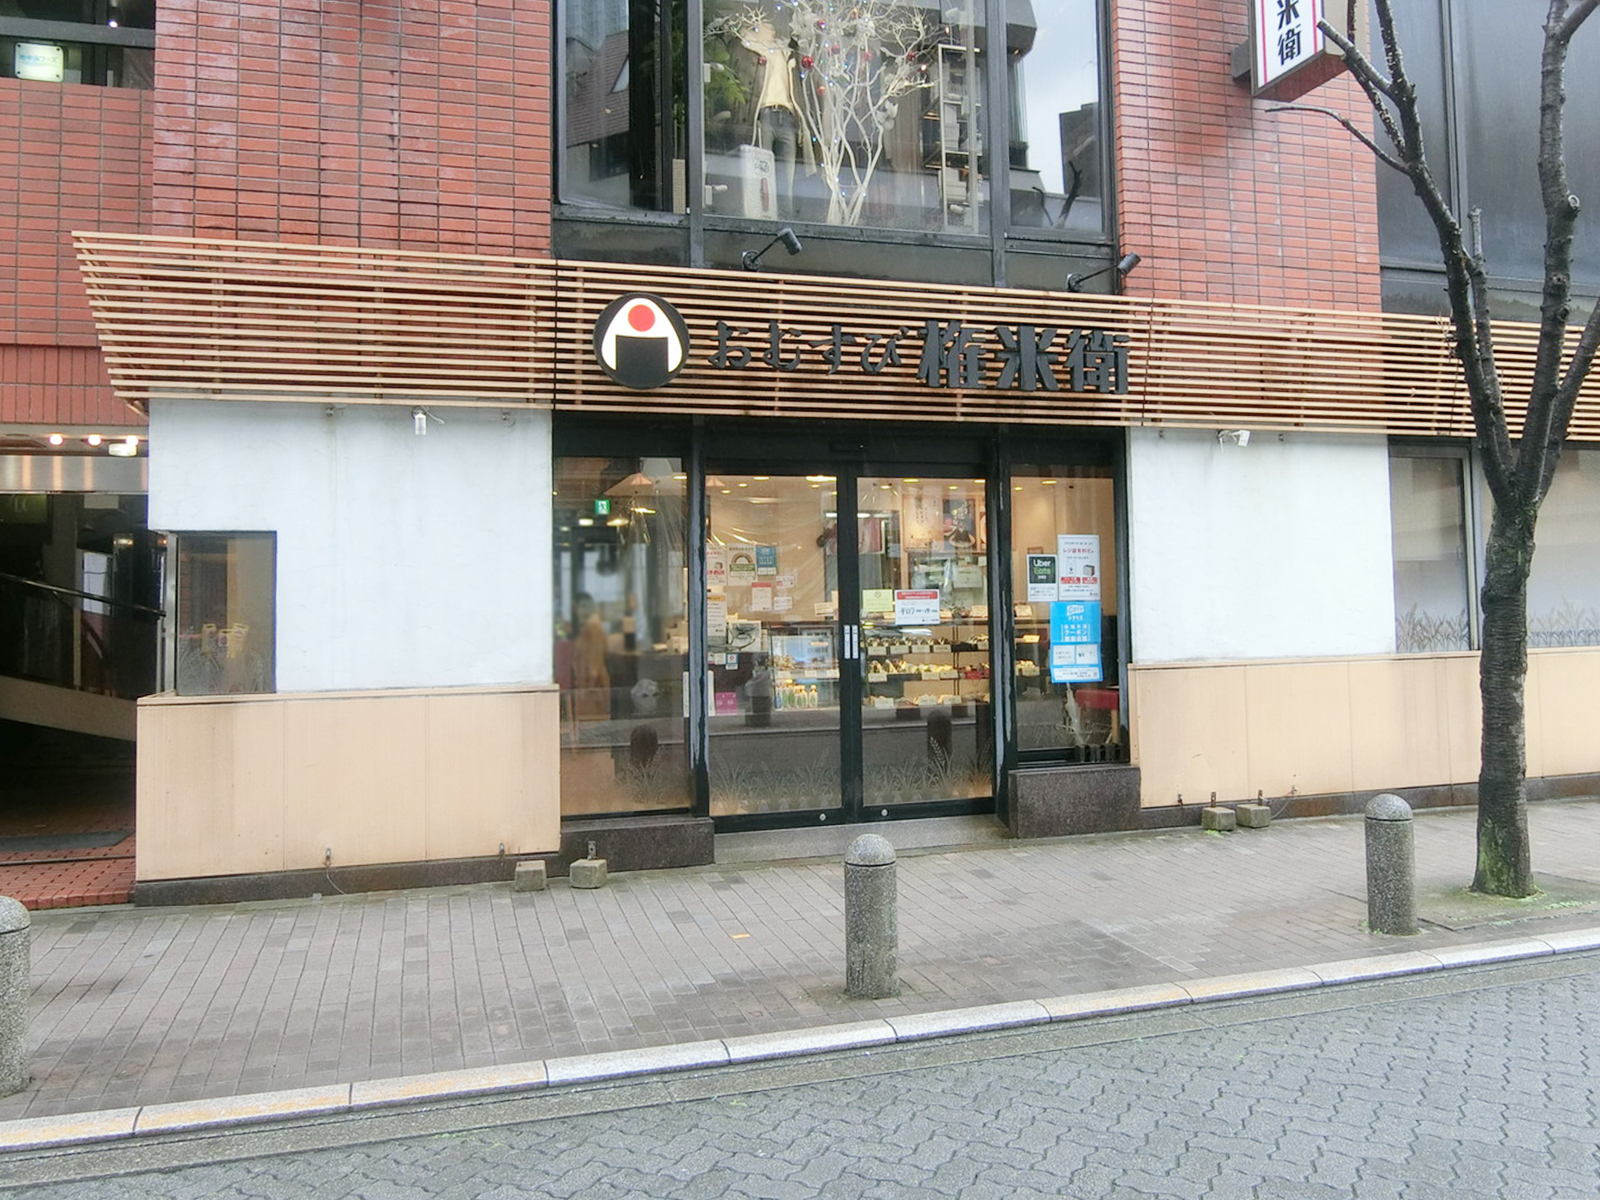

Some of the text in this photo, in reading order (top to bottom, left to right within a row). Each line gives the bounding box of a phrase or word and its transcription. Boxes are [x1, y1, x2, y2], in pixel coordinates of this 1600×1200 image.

[708, 319, 1131, 394] おむすび権米衛
[1033, 559, 1052, 567] Uber
[1033, 567, 1052, 575] Eats
